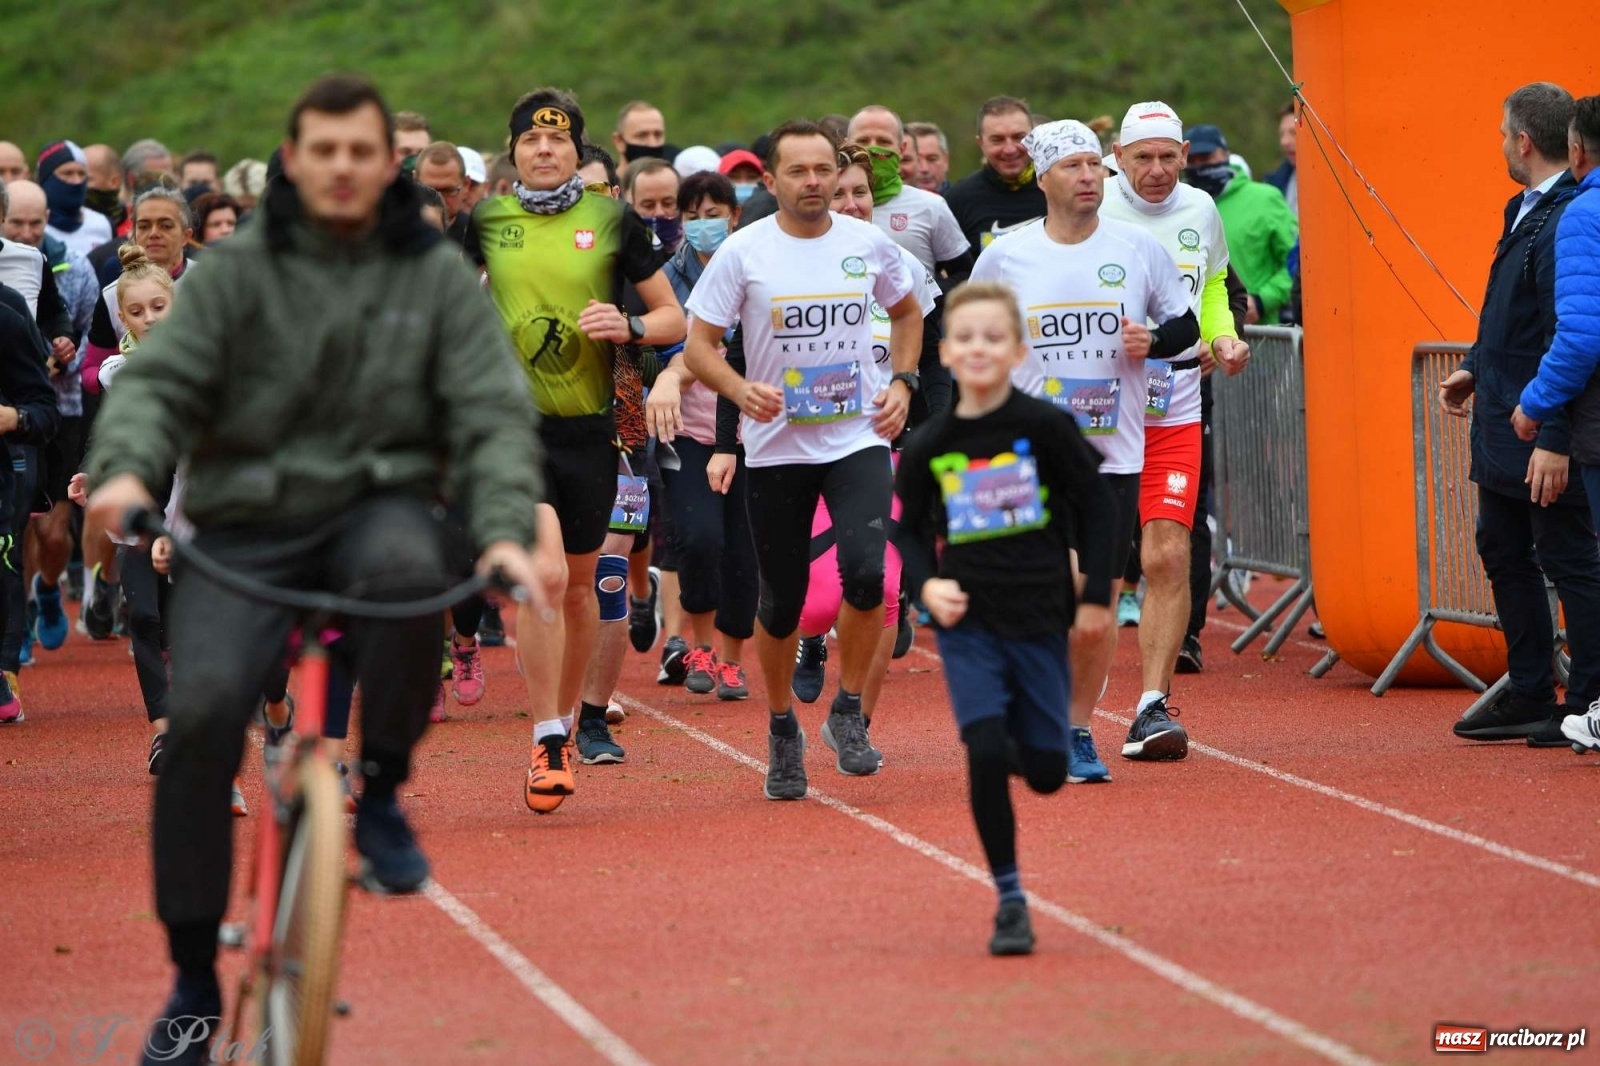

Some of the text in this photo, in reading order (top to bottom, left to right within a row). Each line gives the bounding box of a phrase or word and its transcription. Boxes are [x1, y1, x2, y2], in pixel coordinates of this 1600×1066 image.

[783, 341, 857, 353] KIETRZ
[1043, 350, 1117, 362] KIETRZ
[813, 385, 828, 394] DLA
[833, 399, 856, 415] 273
[1071, 397, 1086, 405] DLA
[1090, 416, 1112, 428] 233
[623, 512, 643, 524] 174
